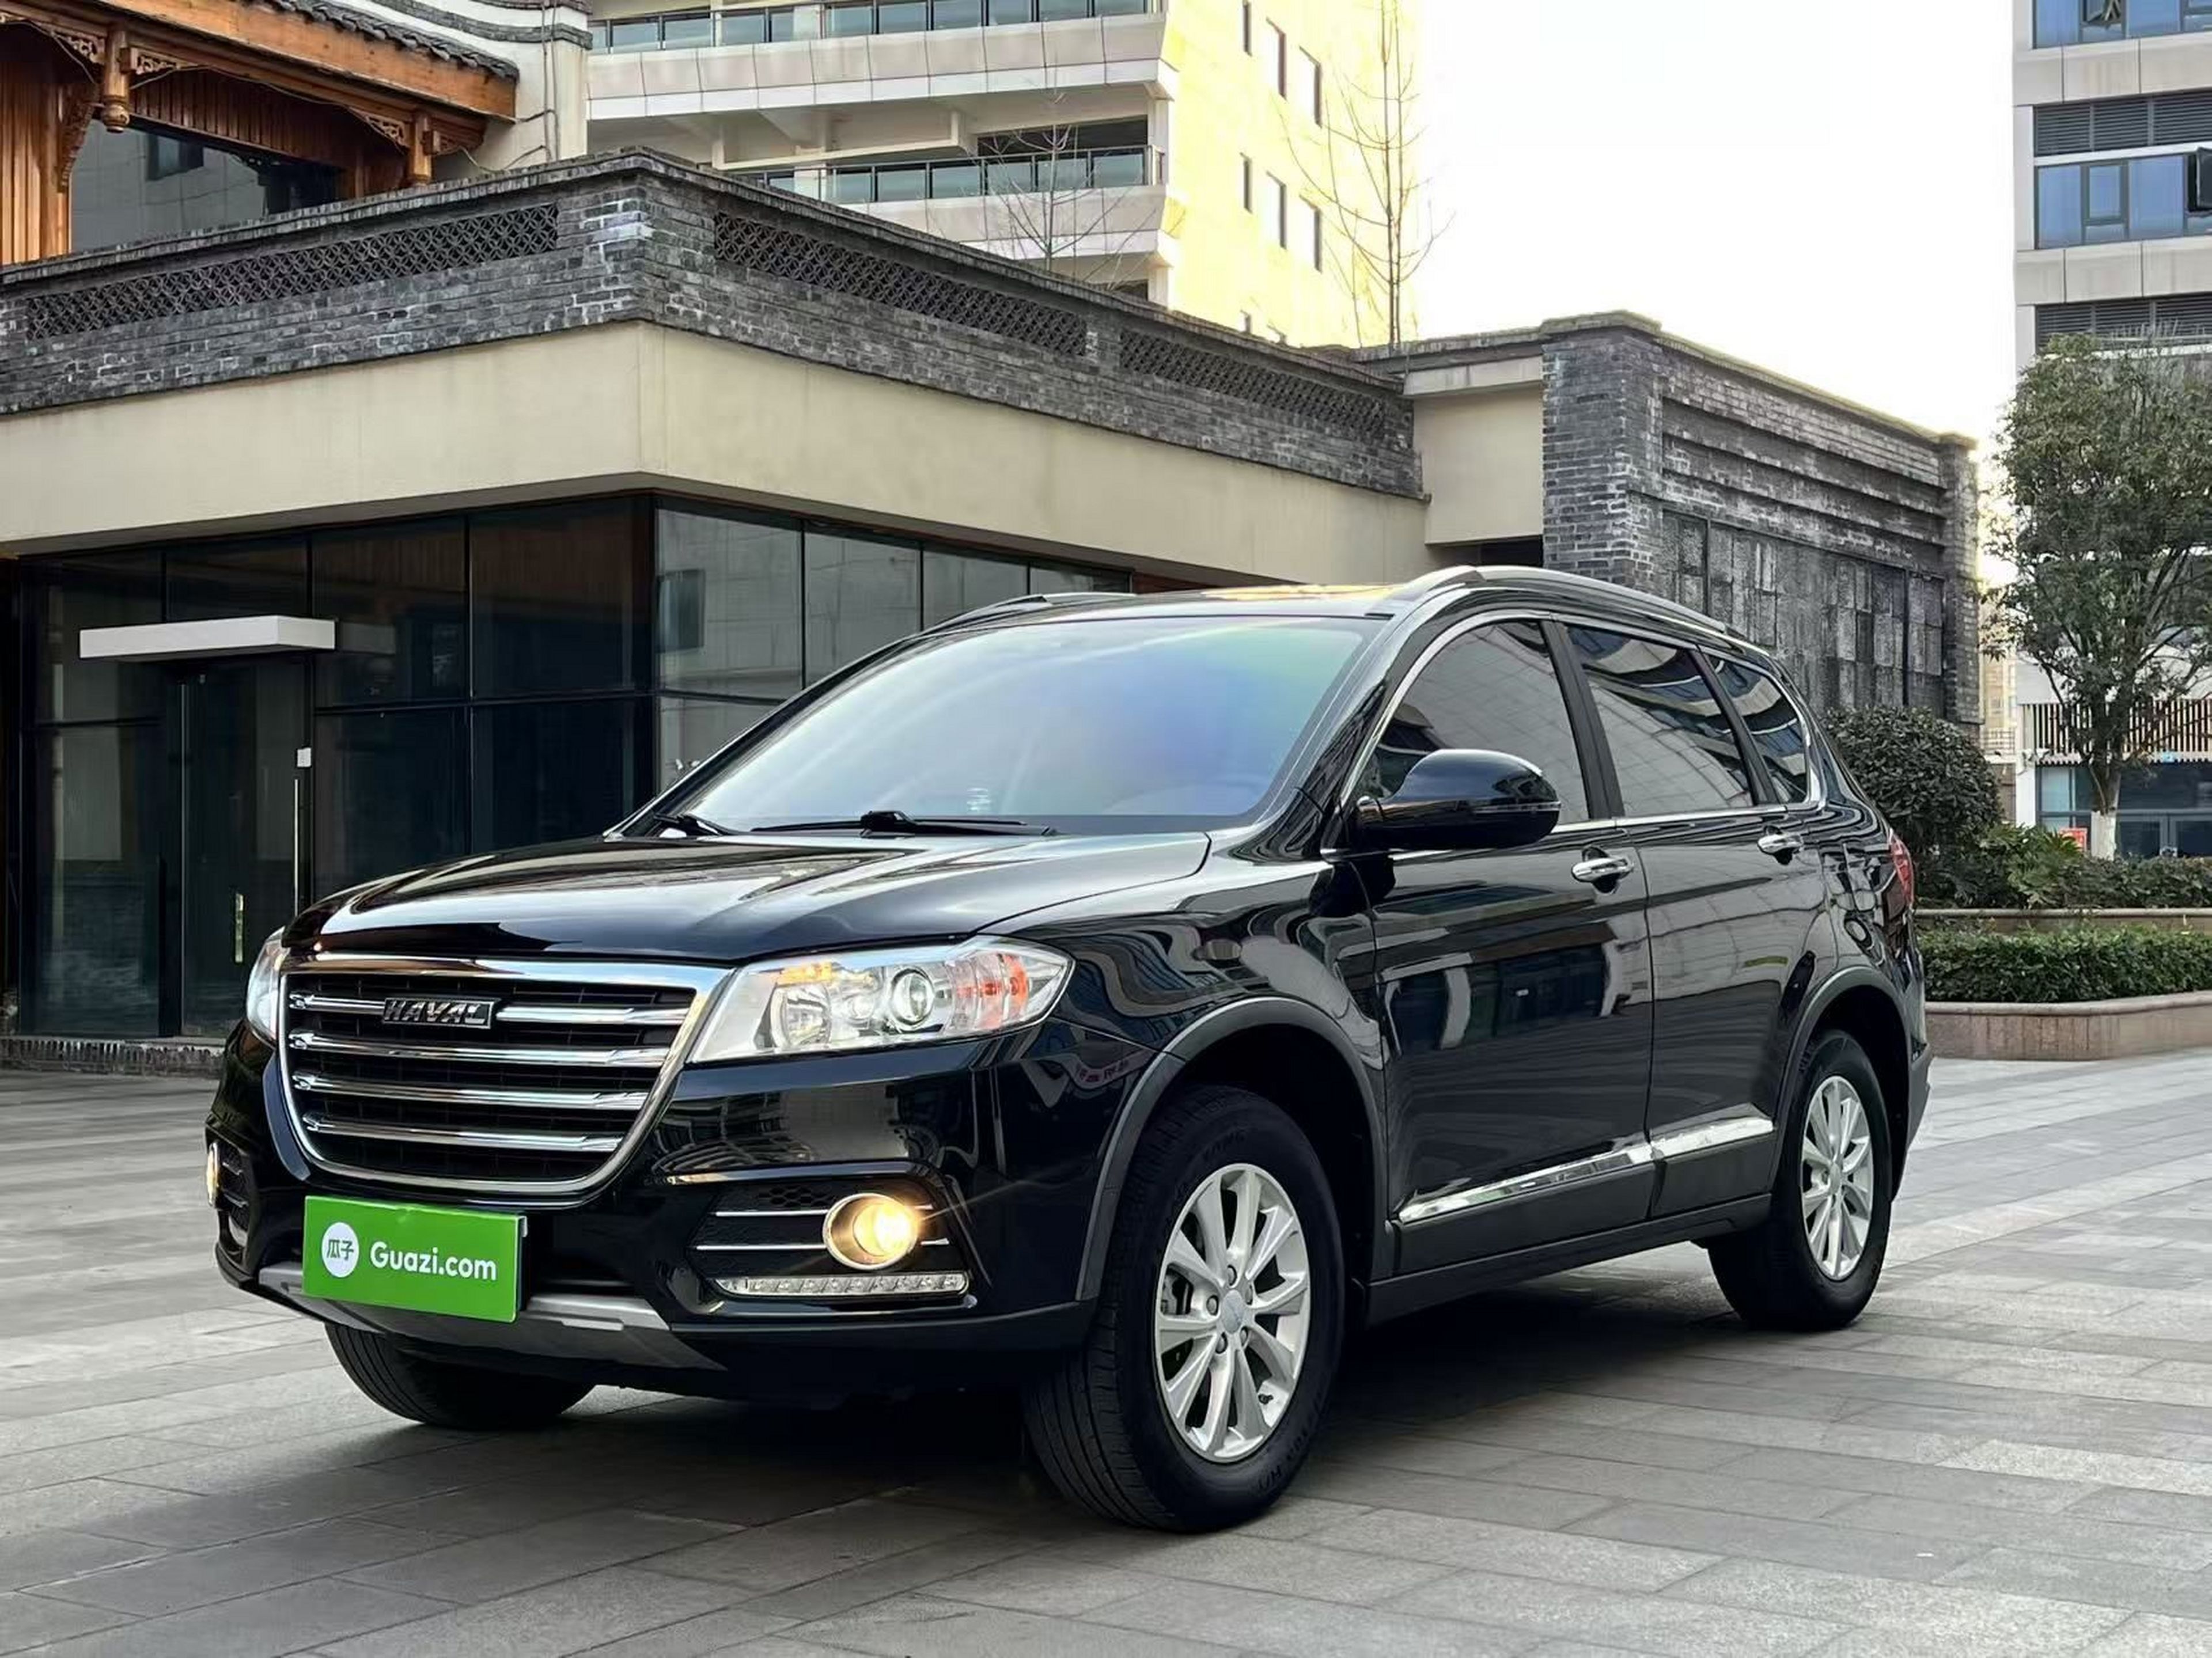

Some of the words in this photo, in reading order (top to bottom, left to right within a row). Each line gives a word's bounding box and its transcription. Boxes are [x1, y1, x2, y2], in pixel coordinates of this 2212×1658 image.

[385, 1001, 486, 1025] HAVAL
[327, 1238, 354, 1261] 瓜子
[370, 1241, 497, 1281] Guazi.com
